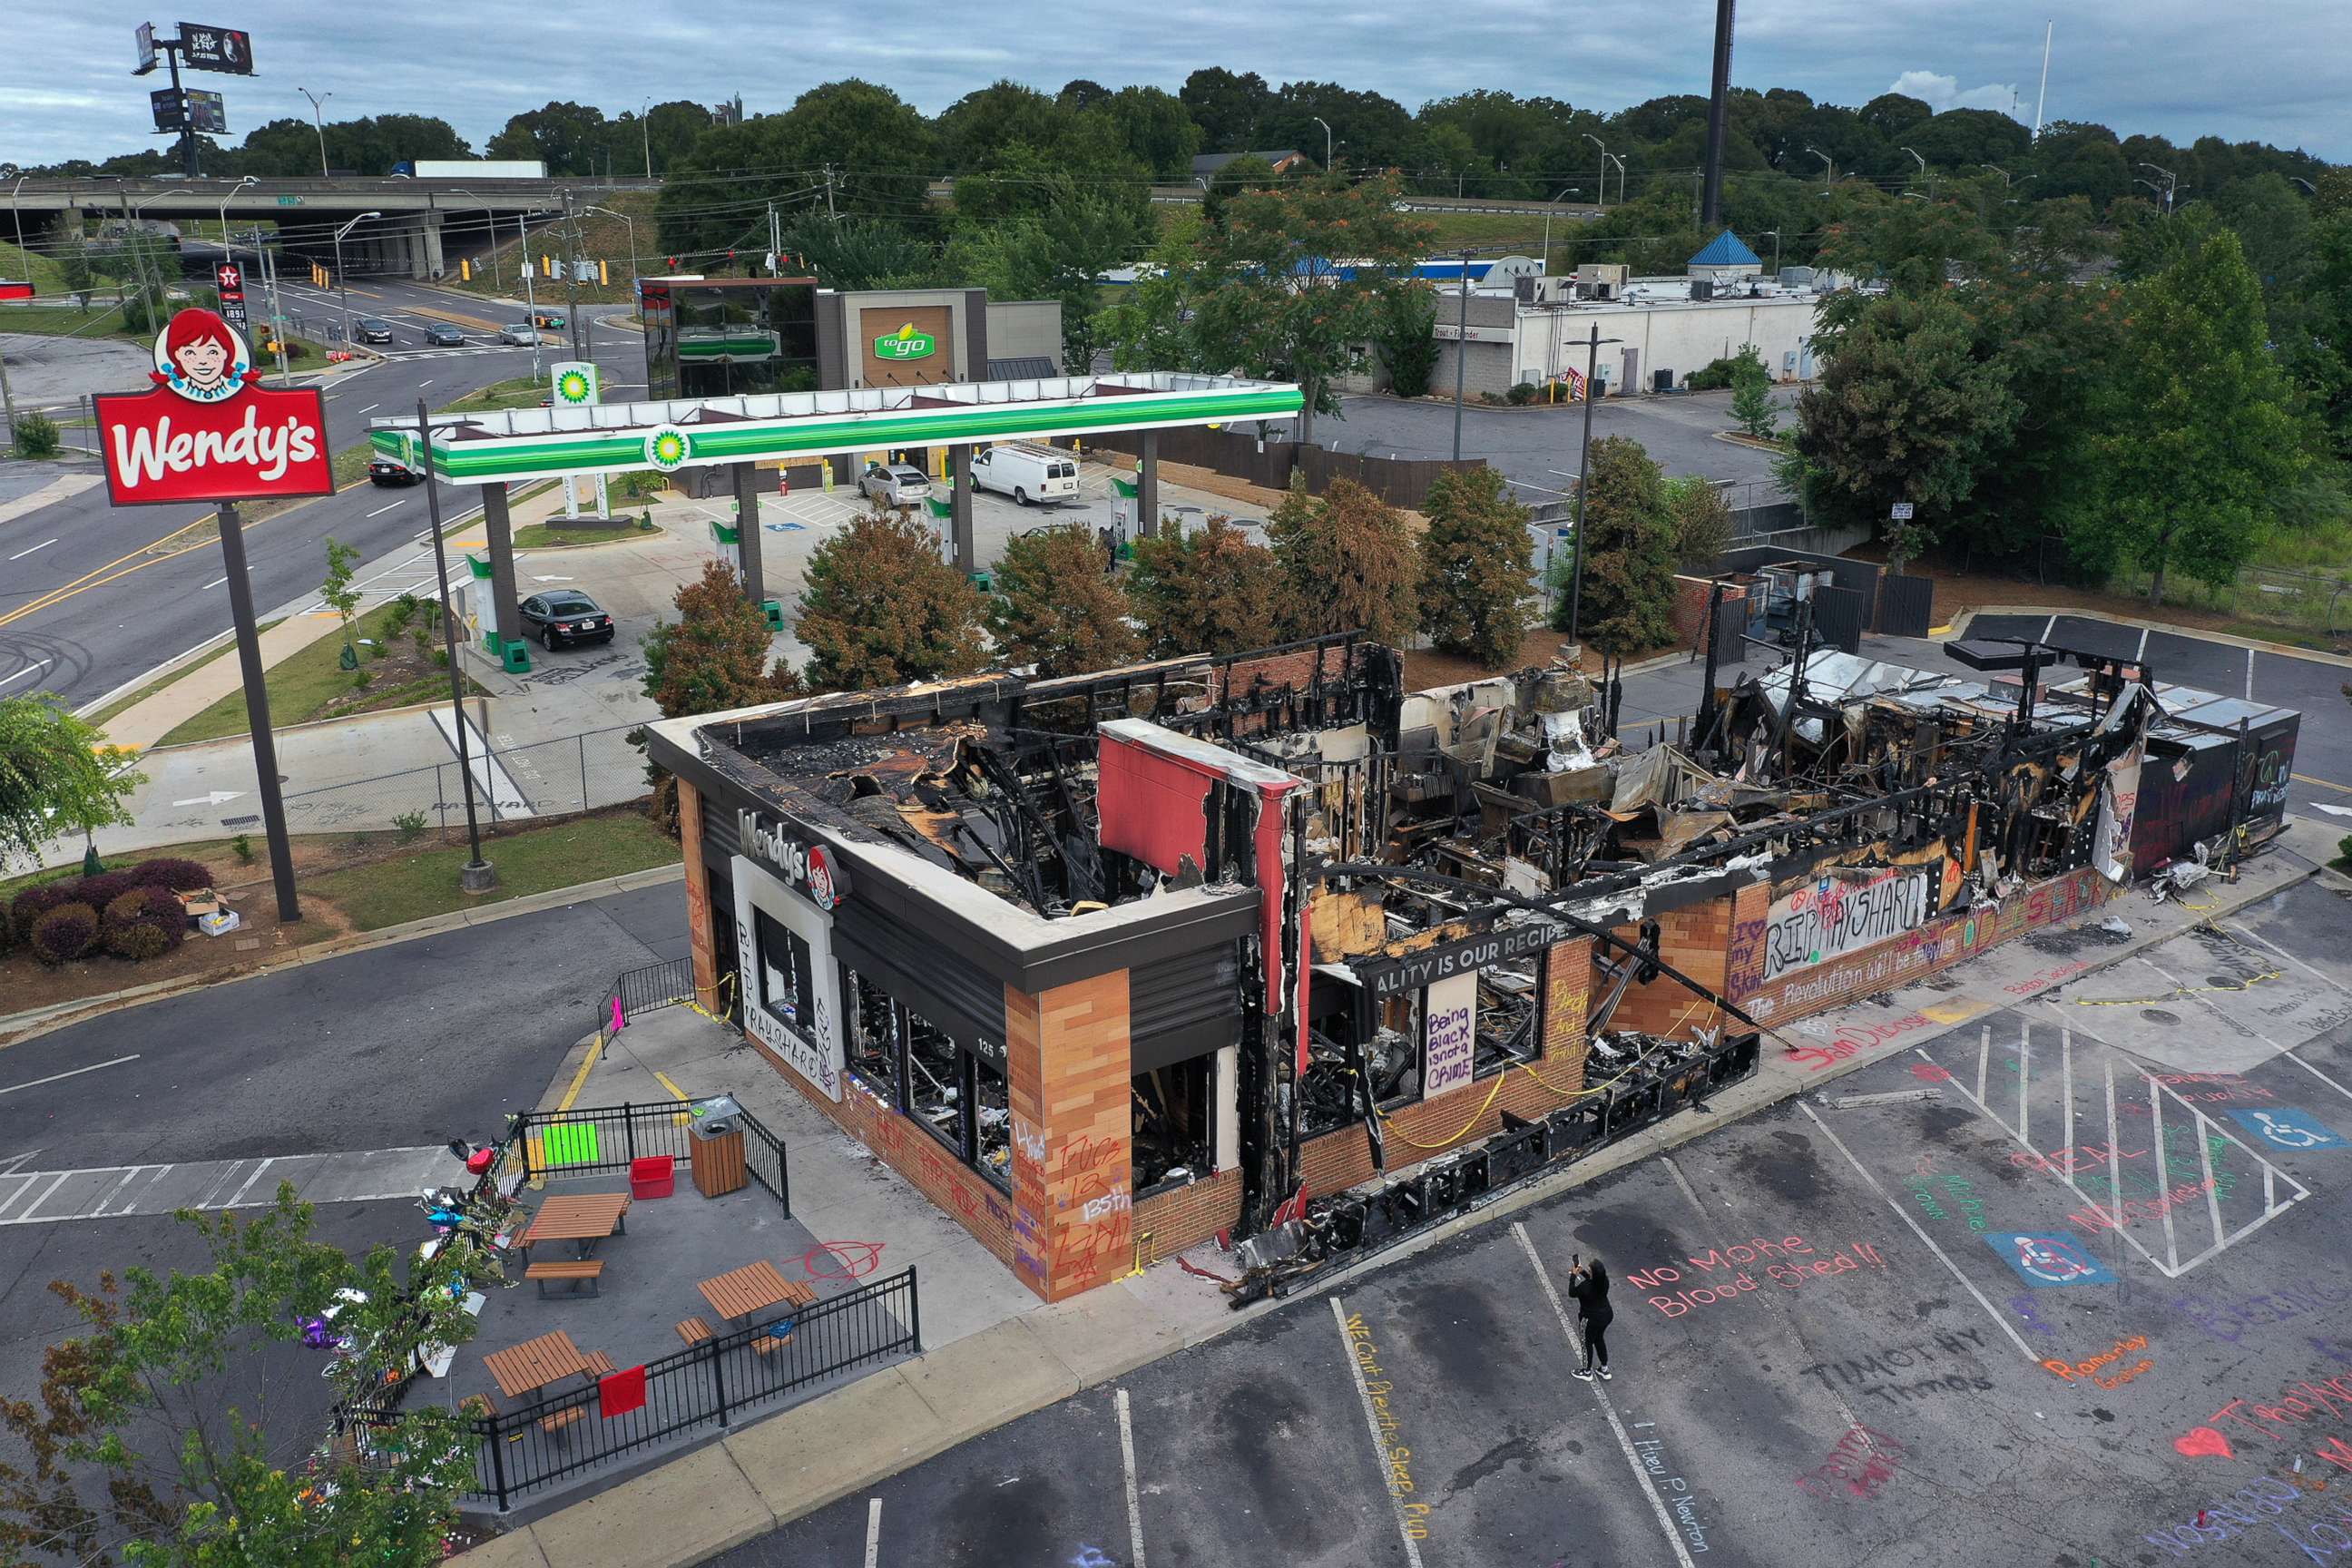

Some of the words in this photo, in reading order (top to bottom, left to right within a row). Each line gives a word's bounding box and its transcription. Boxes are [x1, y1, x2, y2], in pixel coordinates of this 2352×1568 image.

[895, 339, 926, 356] go
[112, 405, 318, 488] Wendy's
[738, 808, 804, 887] Wendy's
[1762, 909, 1818, 980] RIP
[1818, 874, 1922, 953] RAYSHARD
[1377, 960, 1433, 993] ALITY
[1437, 955, 1454, 976] IS
[1459, 942, 1499, 967] OUR
[1427, 1006, 1469, 1035] Being
[1747, 997, 1775, 1018] The
[978, 1037, 995, 1058] 125
[1428, 1057, 1475, 1090] CRIME
[1647, 1271, 1758, 1318] Blood
[1799, 1328, 1985, 1388] TIMOTHY
[1634, 1439, 1666, 1475] Huey
[1671, 1494, 1710, 1553] Newton
